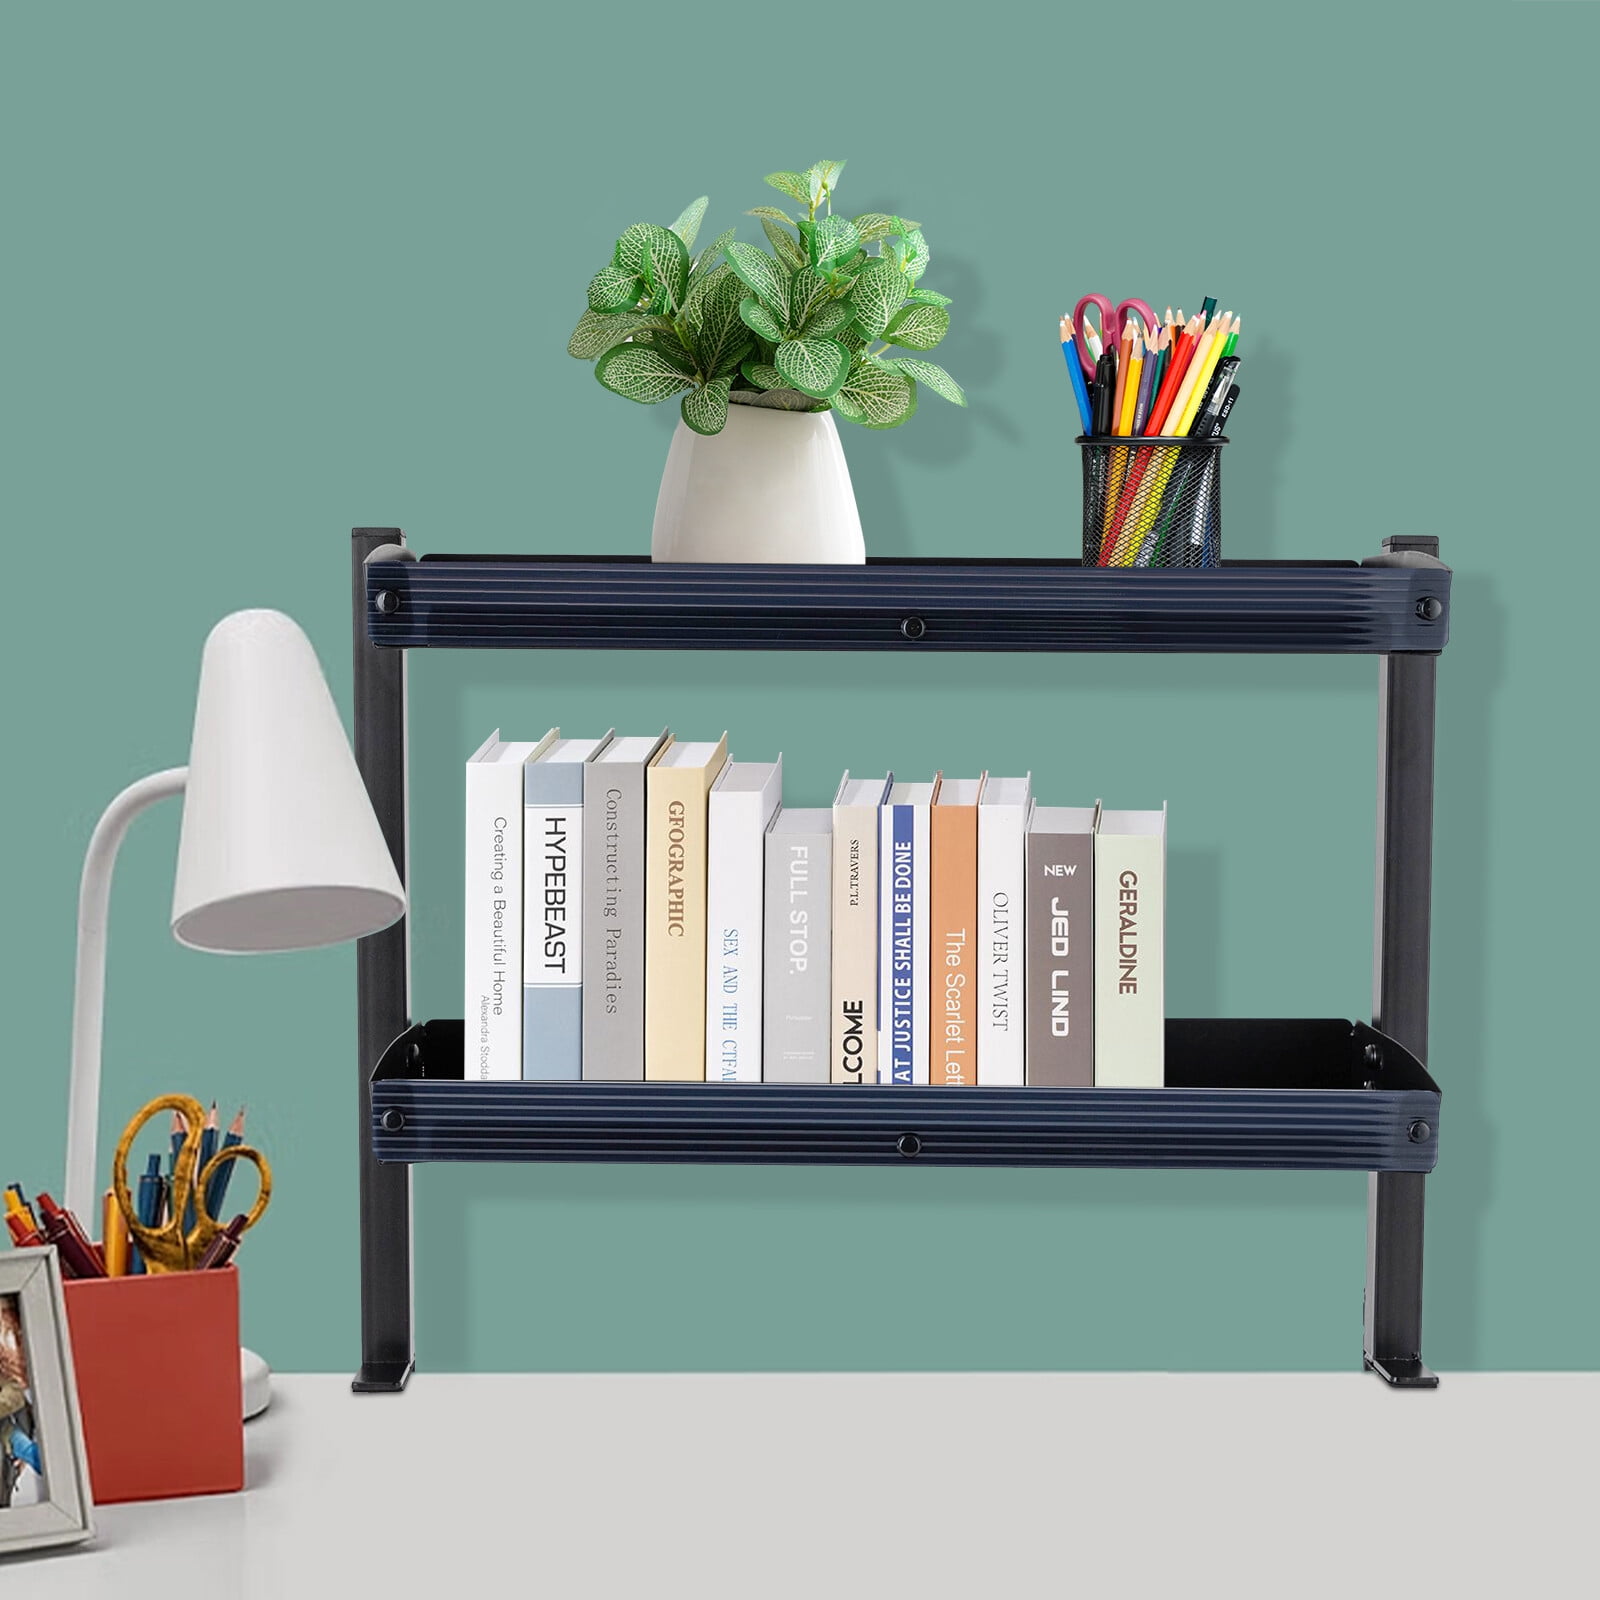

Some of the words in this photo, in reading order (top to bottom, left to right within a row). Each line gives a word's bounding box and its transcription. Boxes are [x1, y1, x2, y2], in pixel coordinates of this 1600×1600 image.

[491, 817, 507, 880] Creating
[604, 789, 621, 917] Constructing
[668, 801, 684, 936] GFOGRAPHIC
[790, 846, 808, 904] FULL
[895, 841, 912, 888] DONE
[1045, 865, 1076, 876] NEW
[545, 818, 566, 973] HYPEBEAST
[895, 893, 912, 914] BE
[493, 900, 506, 965] Beautiful
[724, 929, 738, 955] SEX
[790, 911, 808, 974] STOP.
[895, 917, 912, 970] SHALL
[946, 928, 965, 966] The
[993, 893, 1008, 964] OLIVER
[1052, 897, 1068, 956] JED
[1119, 871, 1137, 994] GERALDINE
[493, 971, 505, 1015] Home
[606, 929, 621, 1013] Paradies
[723, 966, 738, 993] AND
[993, 970, 1008, 1031] TWIST
[481, 995, 490, 1043] Alexandra
[723, 1003, 737, 1030] THE
[895, 978, 912, 1051] JUSTICE
[946, 974, 965, 1043] Scarlet
[1052, 971, 1069, 1036] LIND
[843, 1001, 863, 1083] LCOME
[895, 1059, 912, 1081] AT
